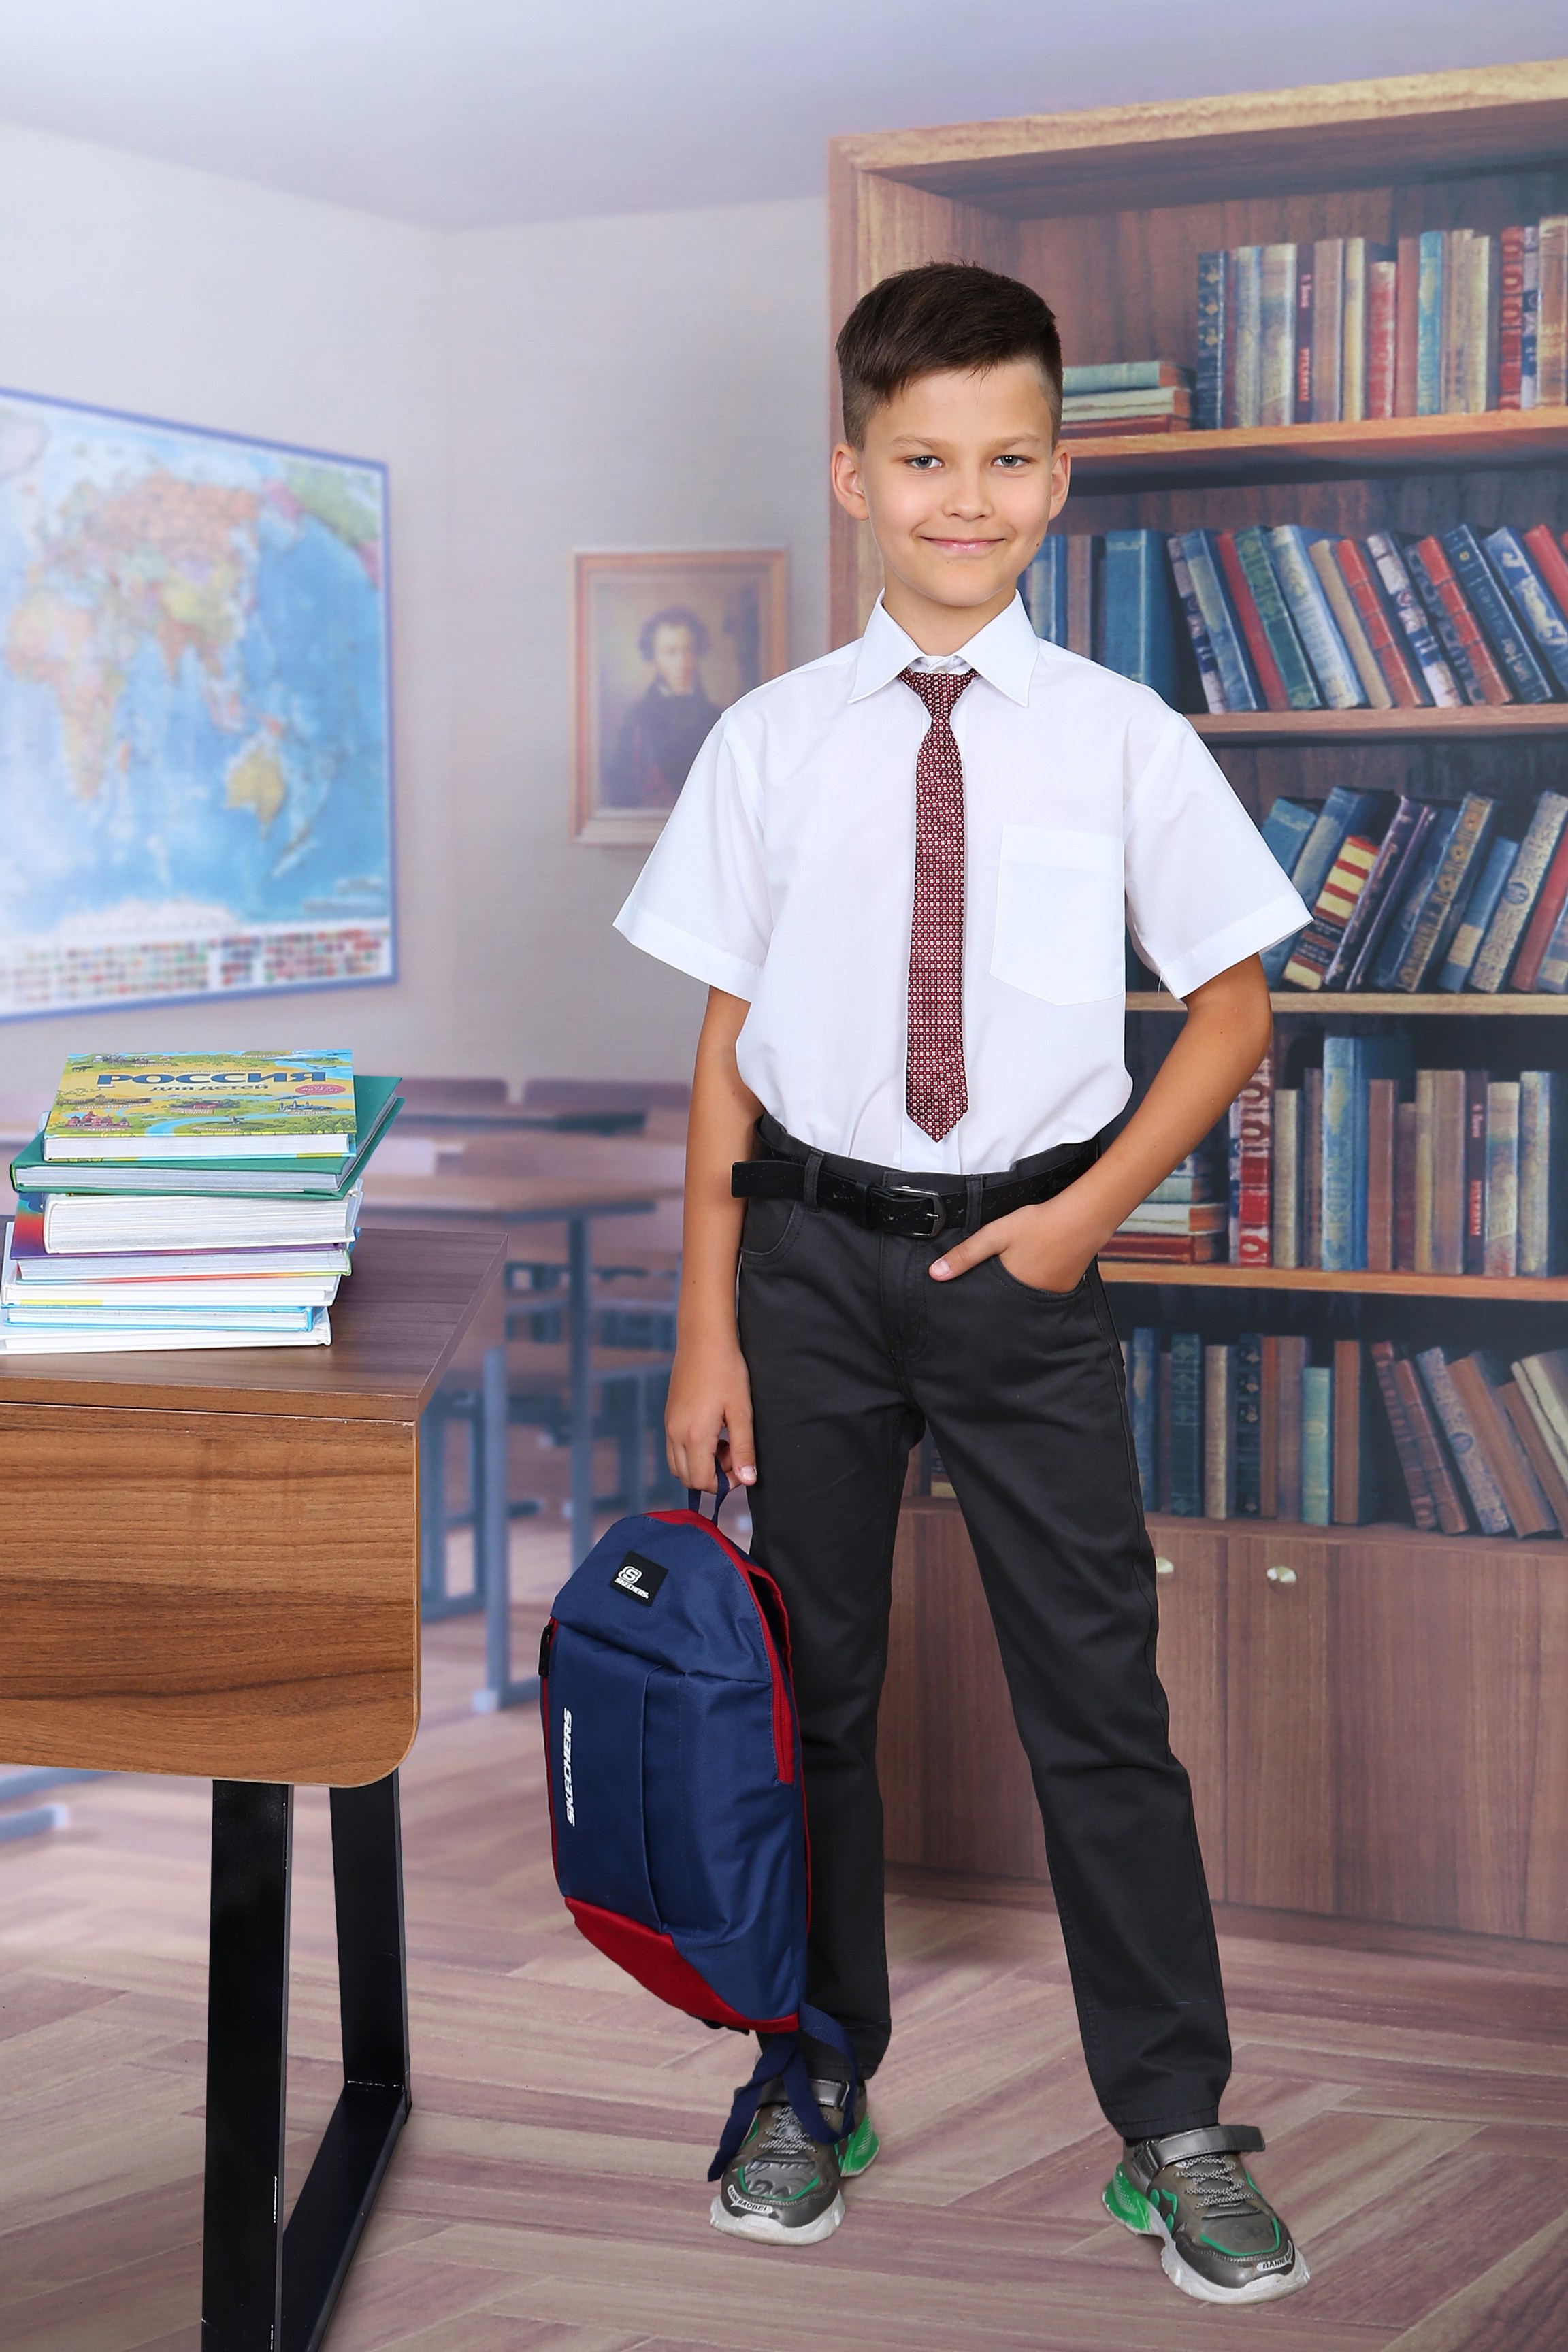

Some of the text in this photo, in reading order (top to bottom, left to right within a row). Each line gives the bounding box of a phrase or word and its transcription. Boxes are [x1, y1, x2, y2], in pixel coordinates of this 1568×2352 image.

[97, 1072, 327, 1086] РОССИЯ
[563, 1707, 576, 1827] SKECHERS
[738, 2199, 768, 2212] BAOBEI
